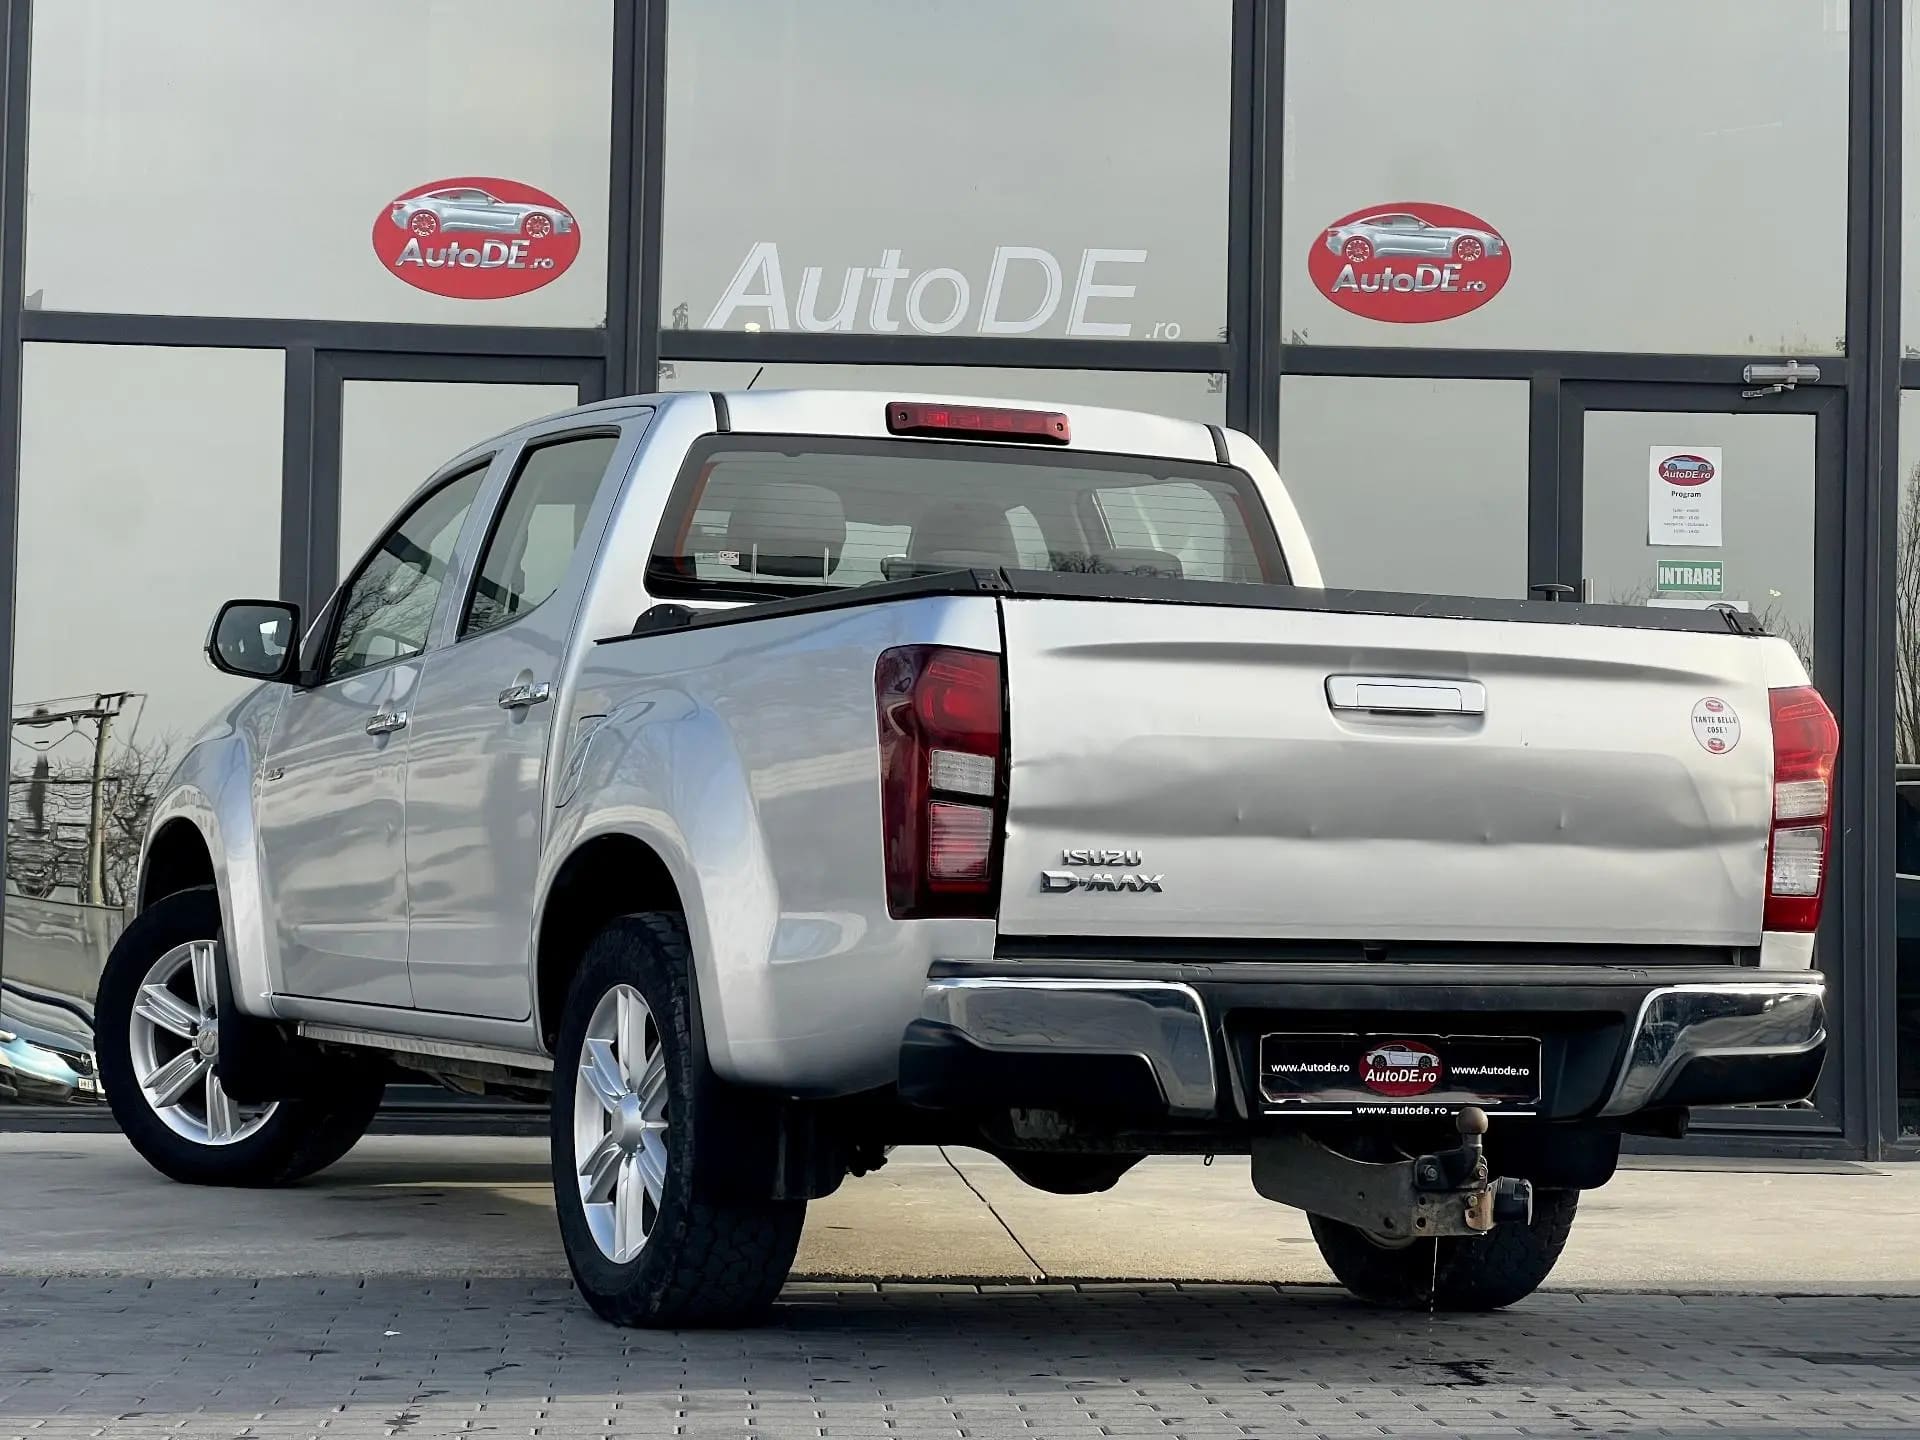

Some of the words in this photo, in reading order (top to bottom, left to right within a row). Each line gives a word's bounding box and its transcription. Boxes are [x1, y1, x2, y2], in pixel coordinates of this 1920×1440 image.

[1671, 490, 1702, 499] Program
[1659, 567, 1721, 586] INTRARE
[1062, 849, 1142, 866] ISUZU
[1040, 870, 1165, 893] D-MAX
[1271, 1062, 1350, 1073] www.Autode.ro
[1451, 1065, 1530, 1077] www.Autode.ro
[1364, 1068, 1437, 1083] AutoDE.ro
[1356, 1105, 1448, 1116] www.autode.ro
